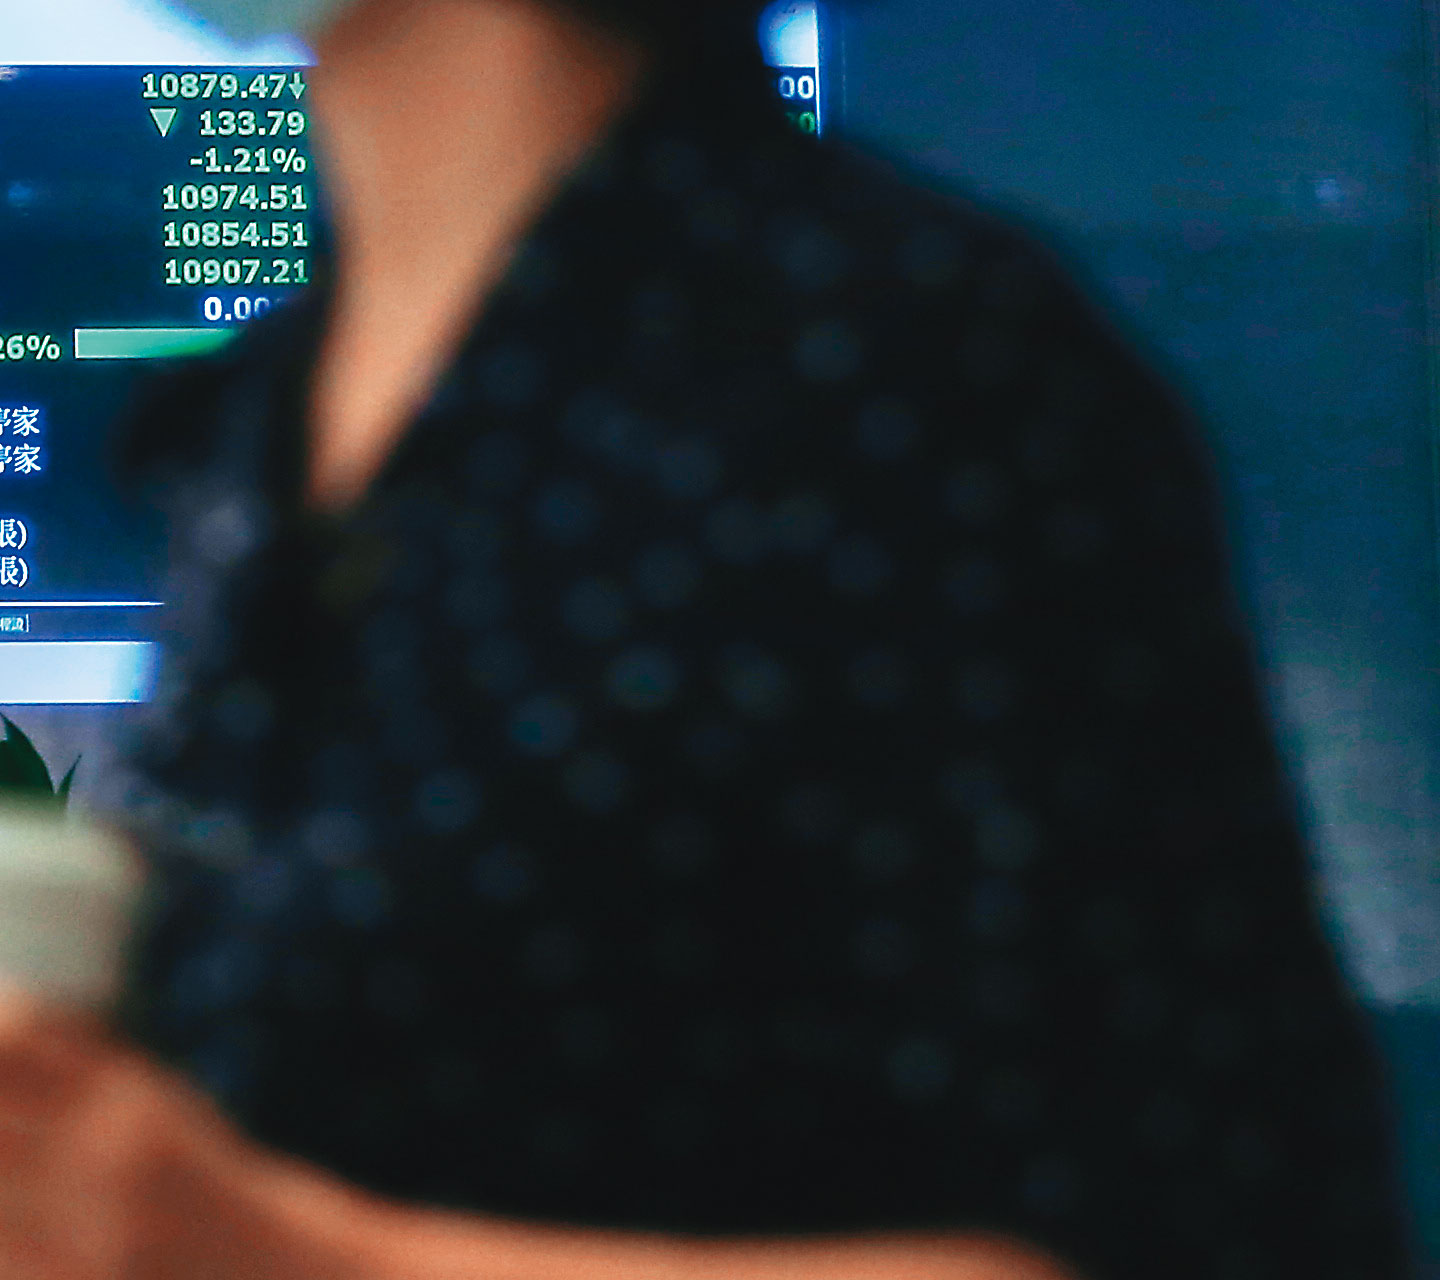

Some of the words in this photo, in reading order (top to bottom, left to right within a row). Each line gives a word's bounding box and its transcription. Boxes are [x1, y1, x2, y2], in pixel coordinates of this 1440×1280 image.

[143, 73, 286, 99] 10879.47
[200, 111, 305, 136] 133.79
[190, 147, 307, 174] -1.21%
[162, 185, 307, 211] 10974.51
[163, 222, 308, 248] 10854.51
[165, 259, 308, 285] 10907.21
